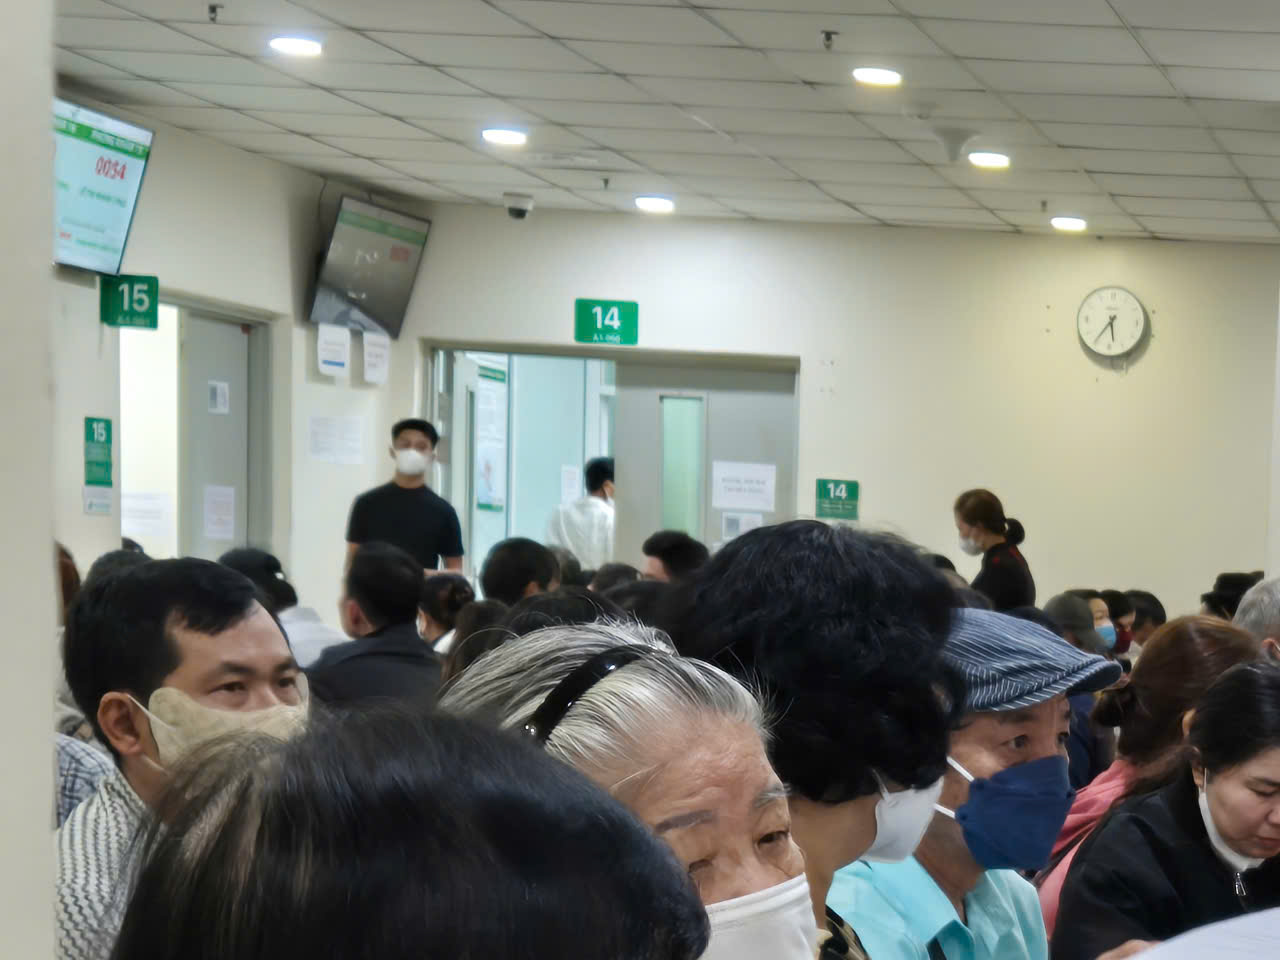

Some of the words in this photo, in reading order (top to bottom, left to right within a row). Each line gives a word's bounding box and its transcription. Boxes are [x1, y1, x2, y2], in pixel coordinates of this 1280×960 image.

[118, 283, 150, 312] 15
[592, 306, 621, 330] 14
[92, 421, 107, 442] 15
[827, 482, 848, 500] 14
